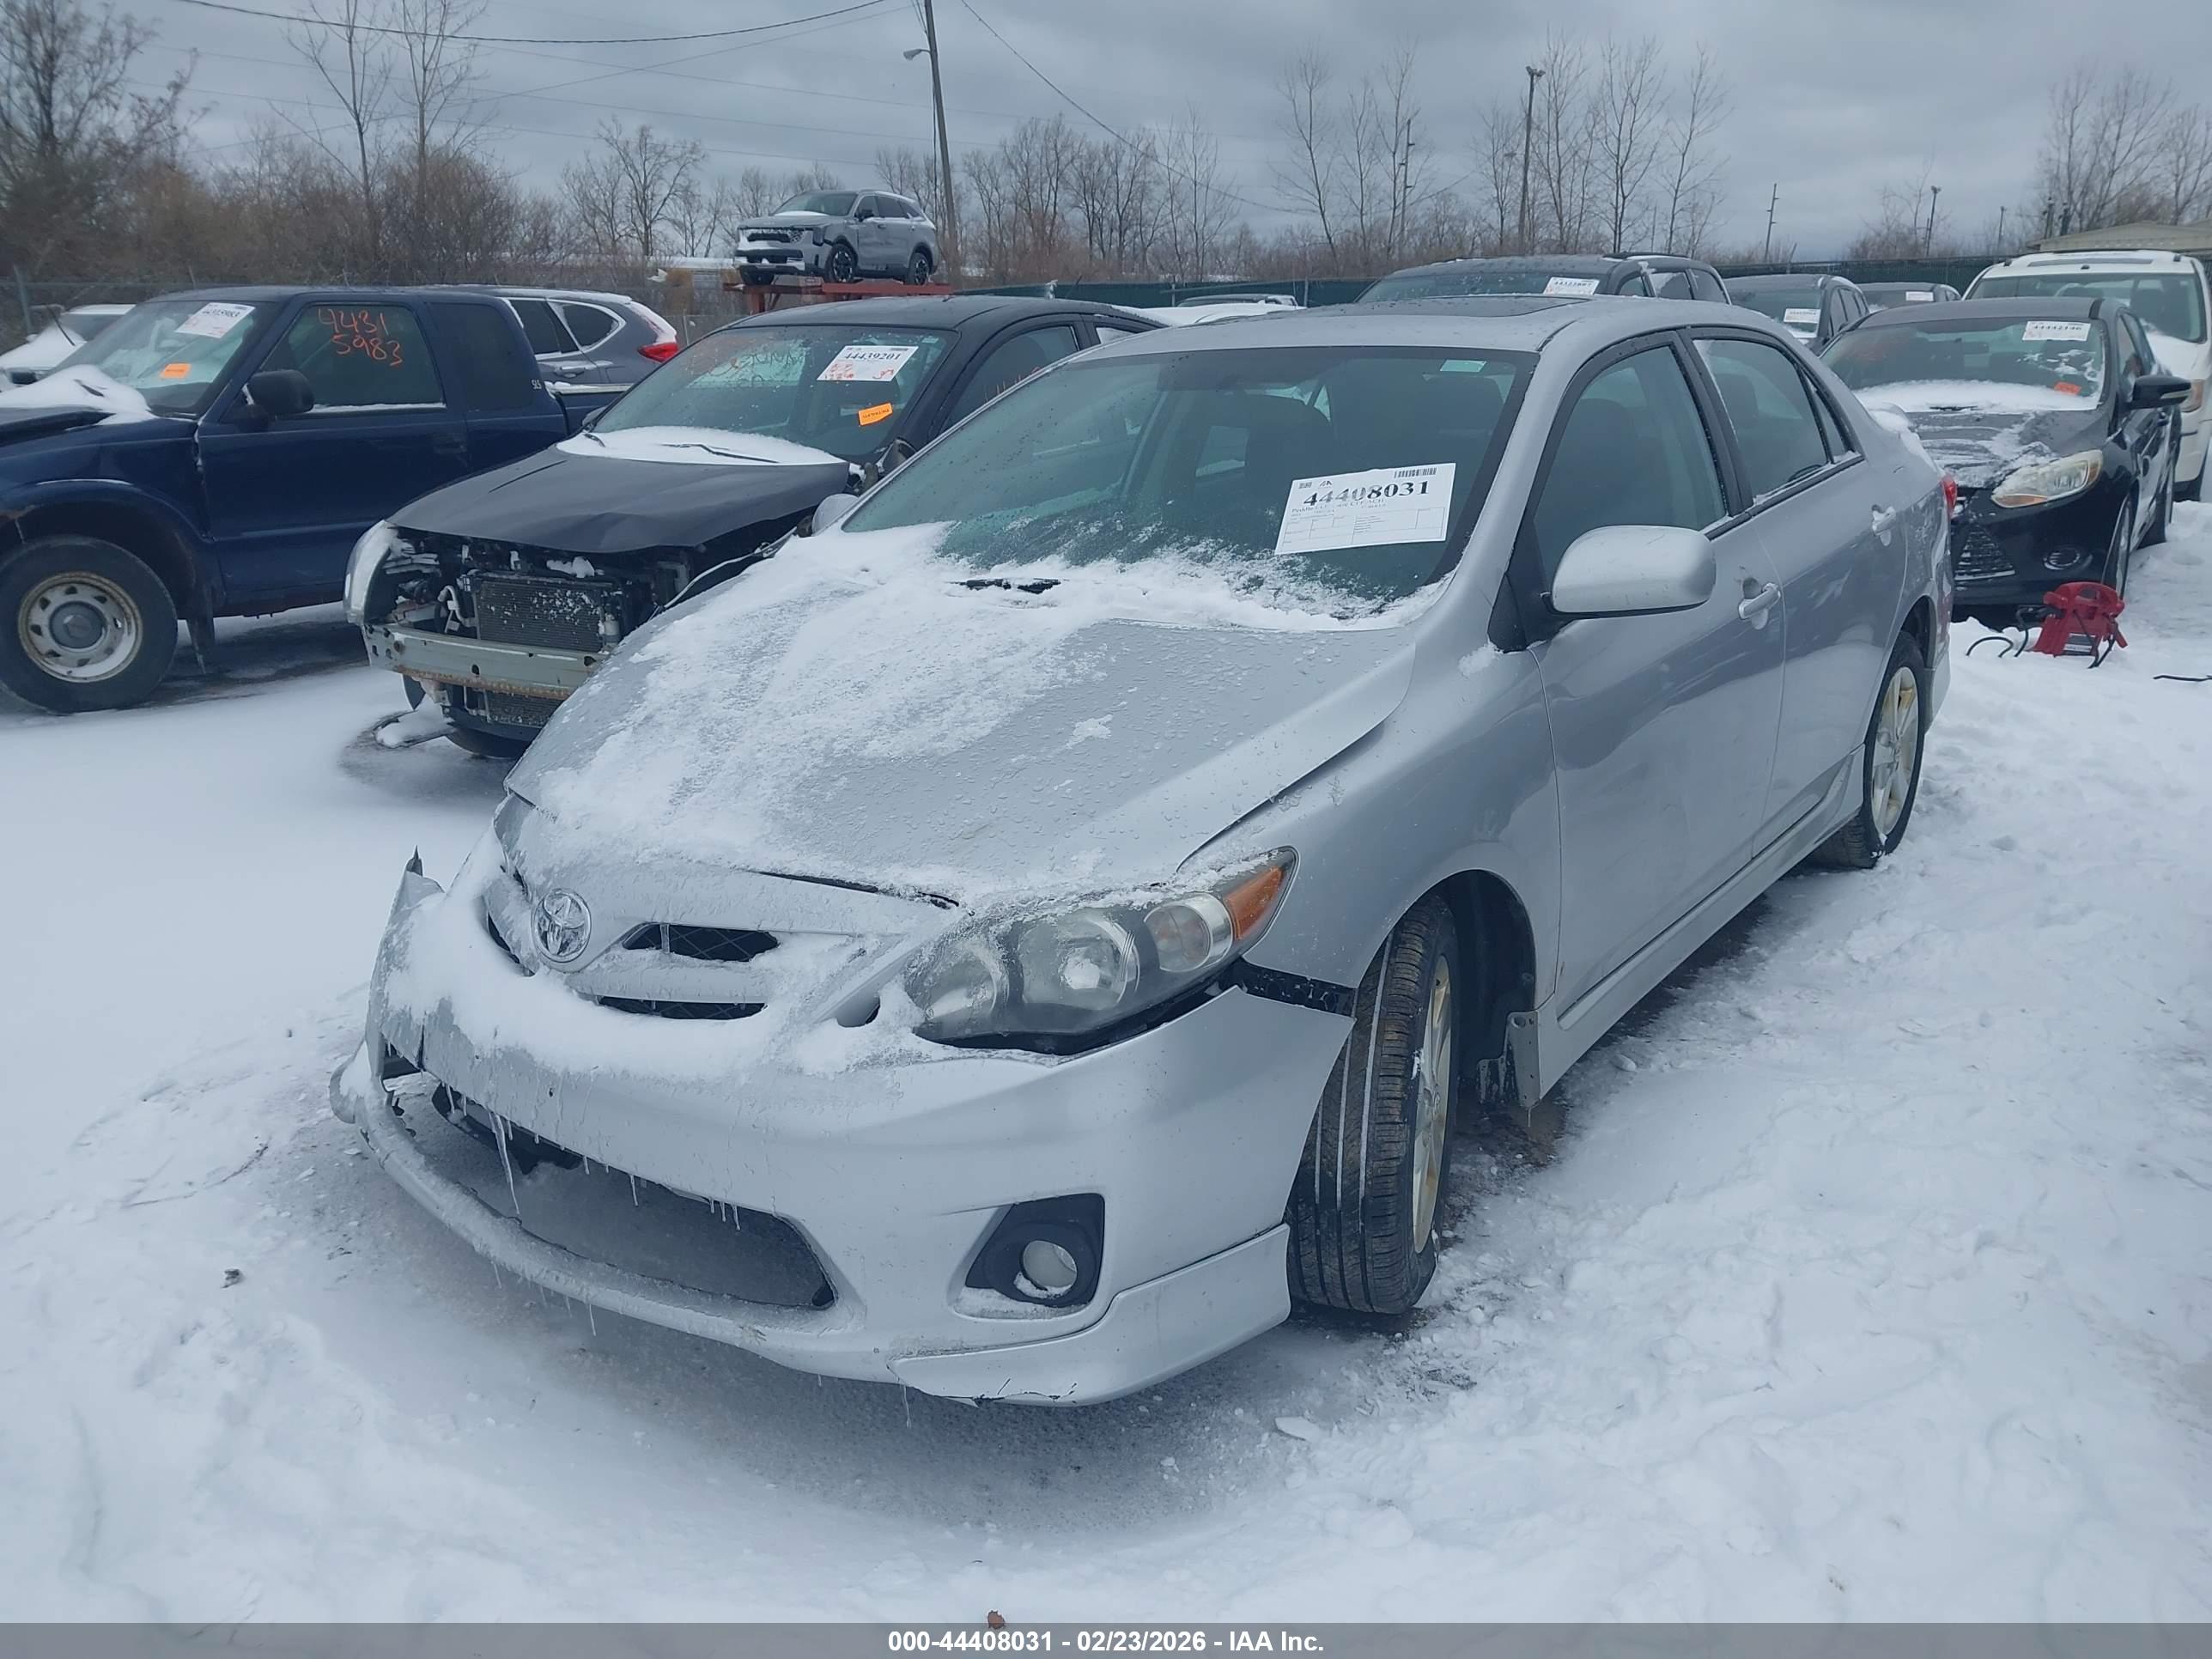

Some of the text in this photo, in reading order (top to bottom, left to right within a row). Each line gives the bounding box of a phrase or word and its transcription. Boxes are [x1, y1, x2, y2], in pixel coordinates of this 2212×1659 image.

[318, 308, 389, 336] 4431
[331, 332, 403, 367] 5983
[1303, 480, 1429, 507] 44408031
